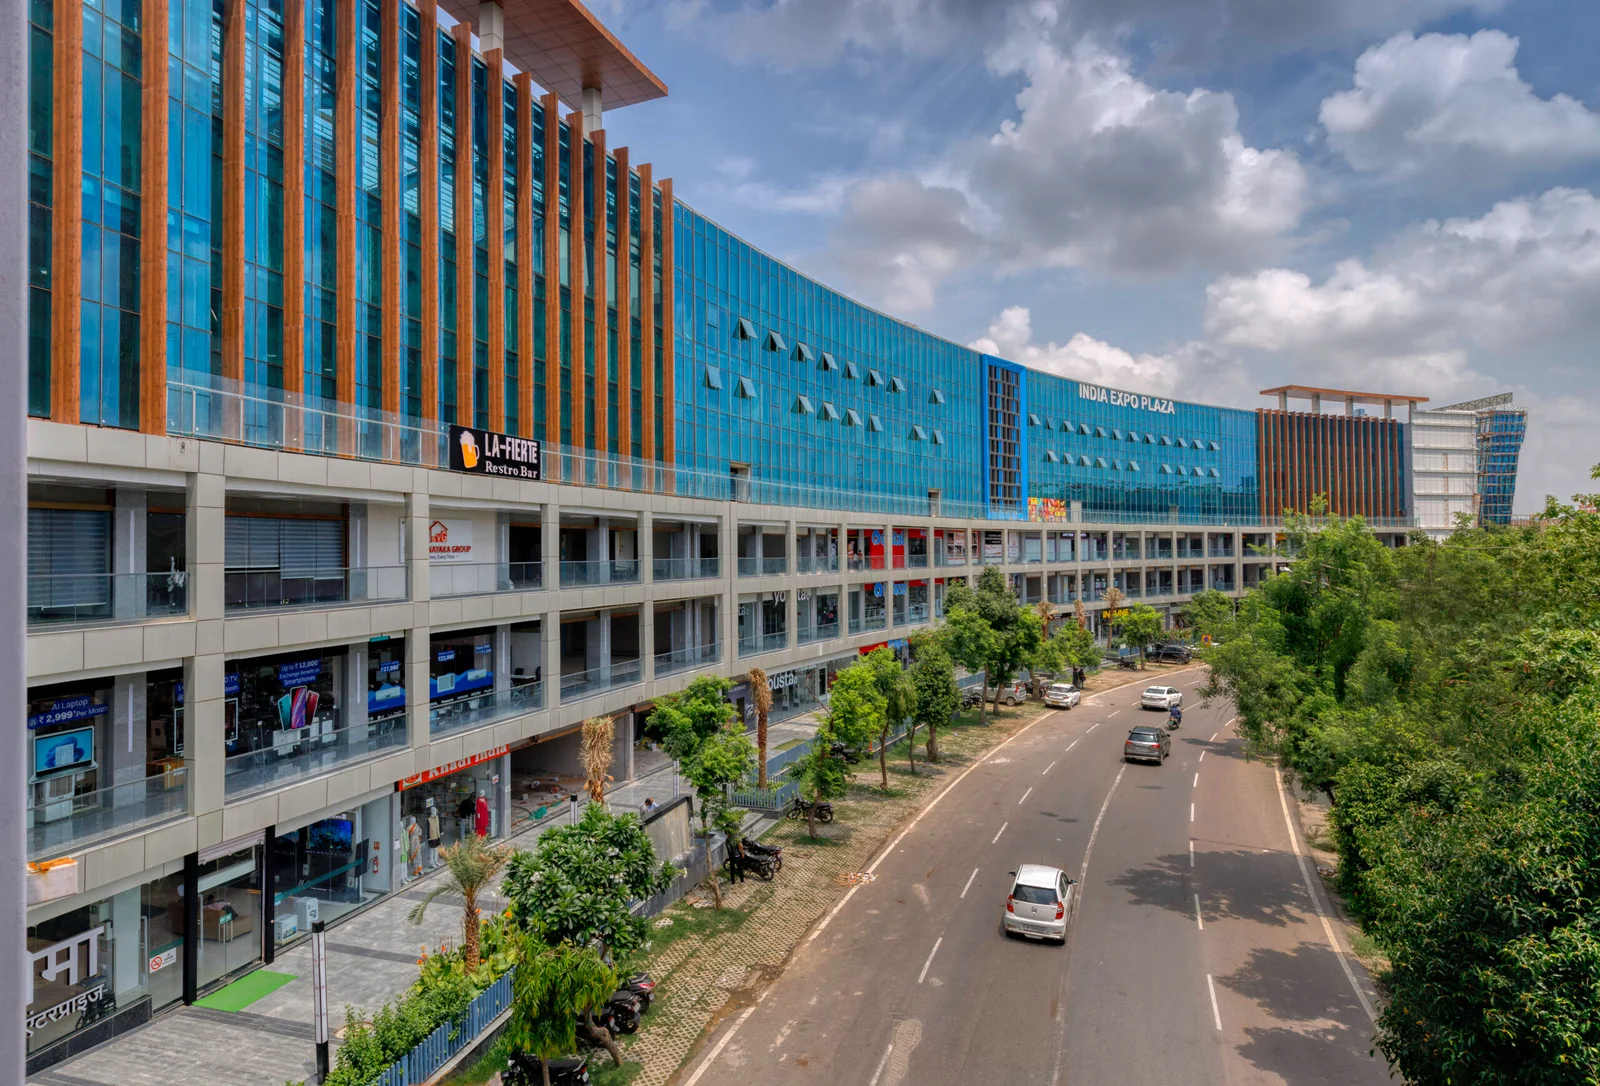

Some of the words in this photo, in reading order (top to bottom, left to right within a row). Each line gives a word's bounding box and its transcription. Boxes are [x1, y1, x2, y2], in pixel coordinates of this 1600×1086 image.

[1079, 383, 1108, 403] INDIA
[1110, 390, 1139, 409] EXPO
[1141, 396, 1175, 415] PLAZA
[485, 460, 519, 476] Restro
[520, 465, 538, 478] Bar
[451, 545, 472, 553] GROUP
[280, 671, 300, 679] Exchange
[284, 675, 316, 686] Smartphones
[61, 699, 88, 710] Laptop
[76, 709, 87, 717] Per
[88, 705, 109, 715] Month
